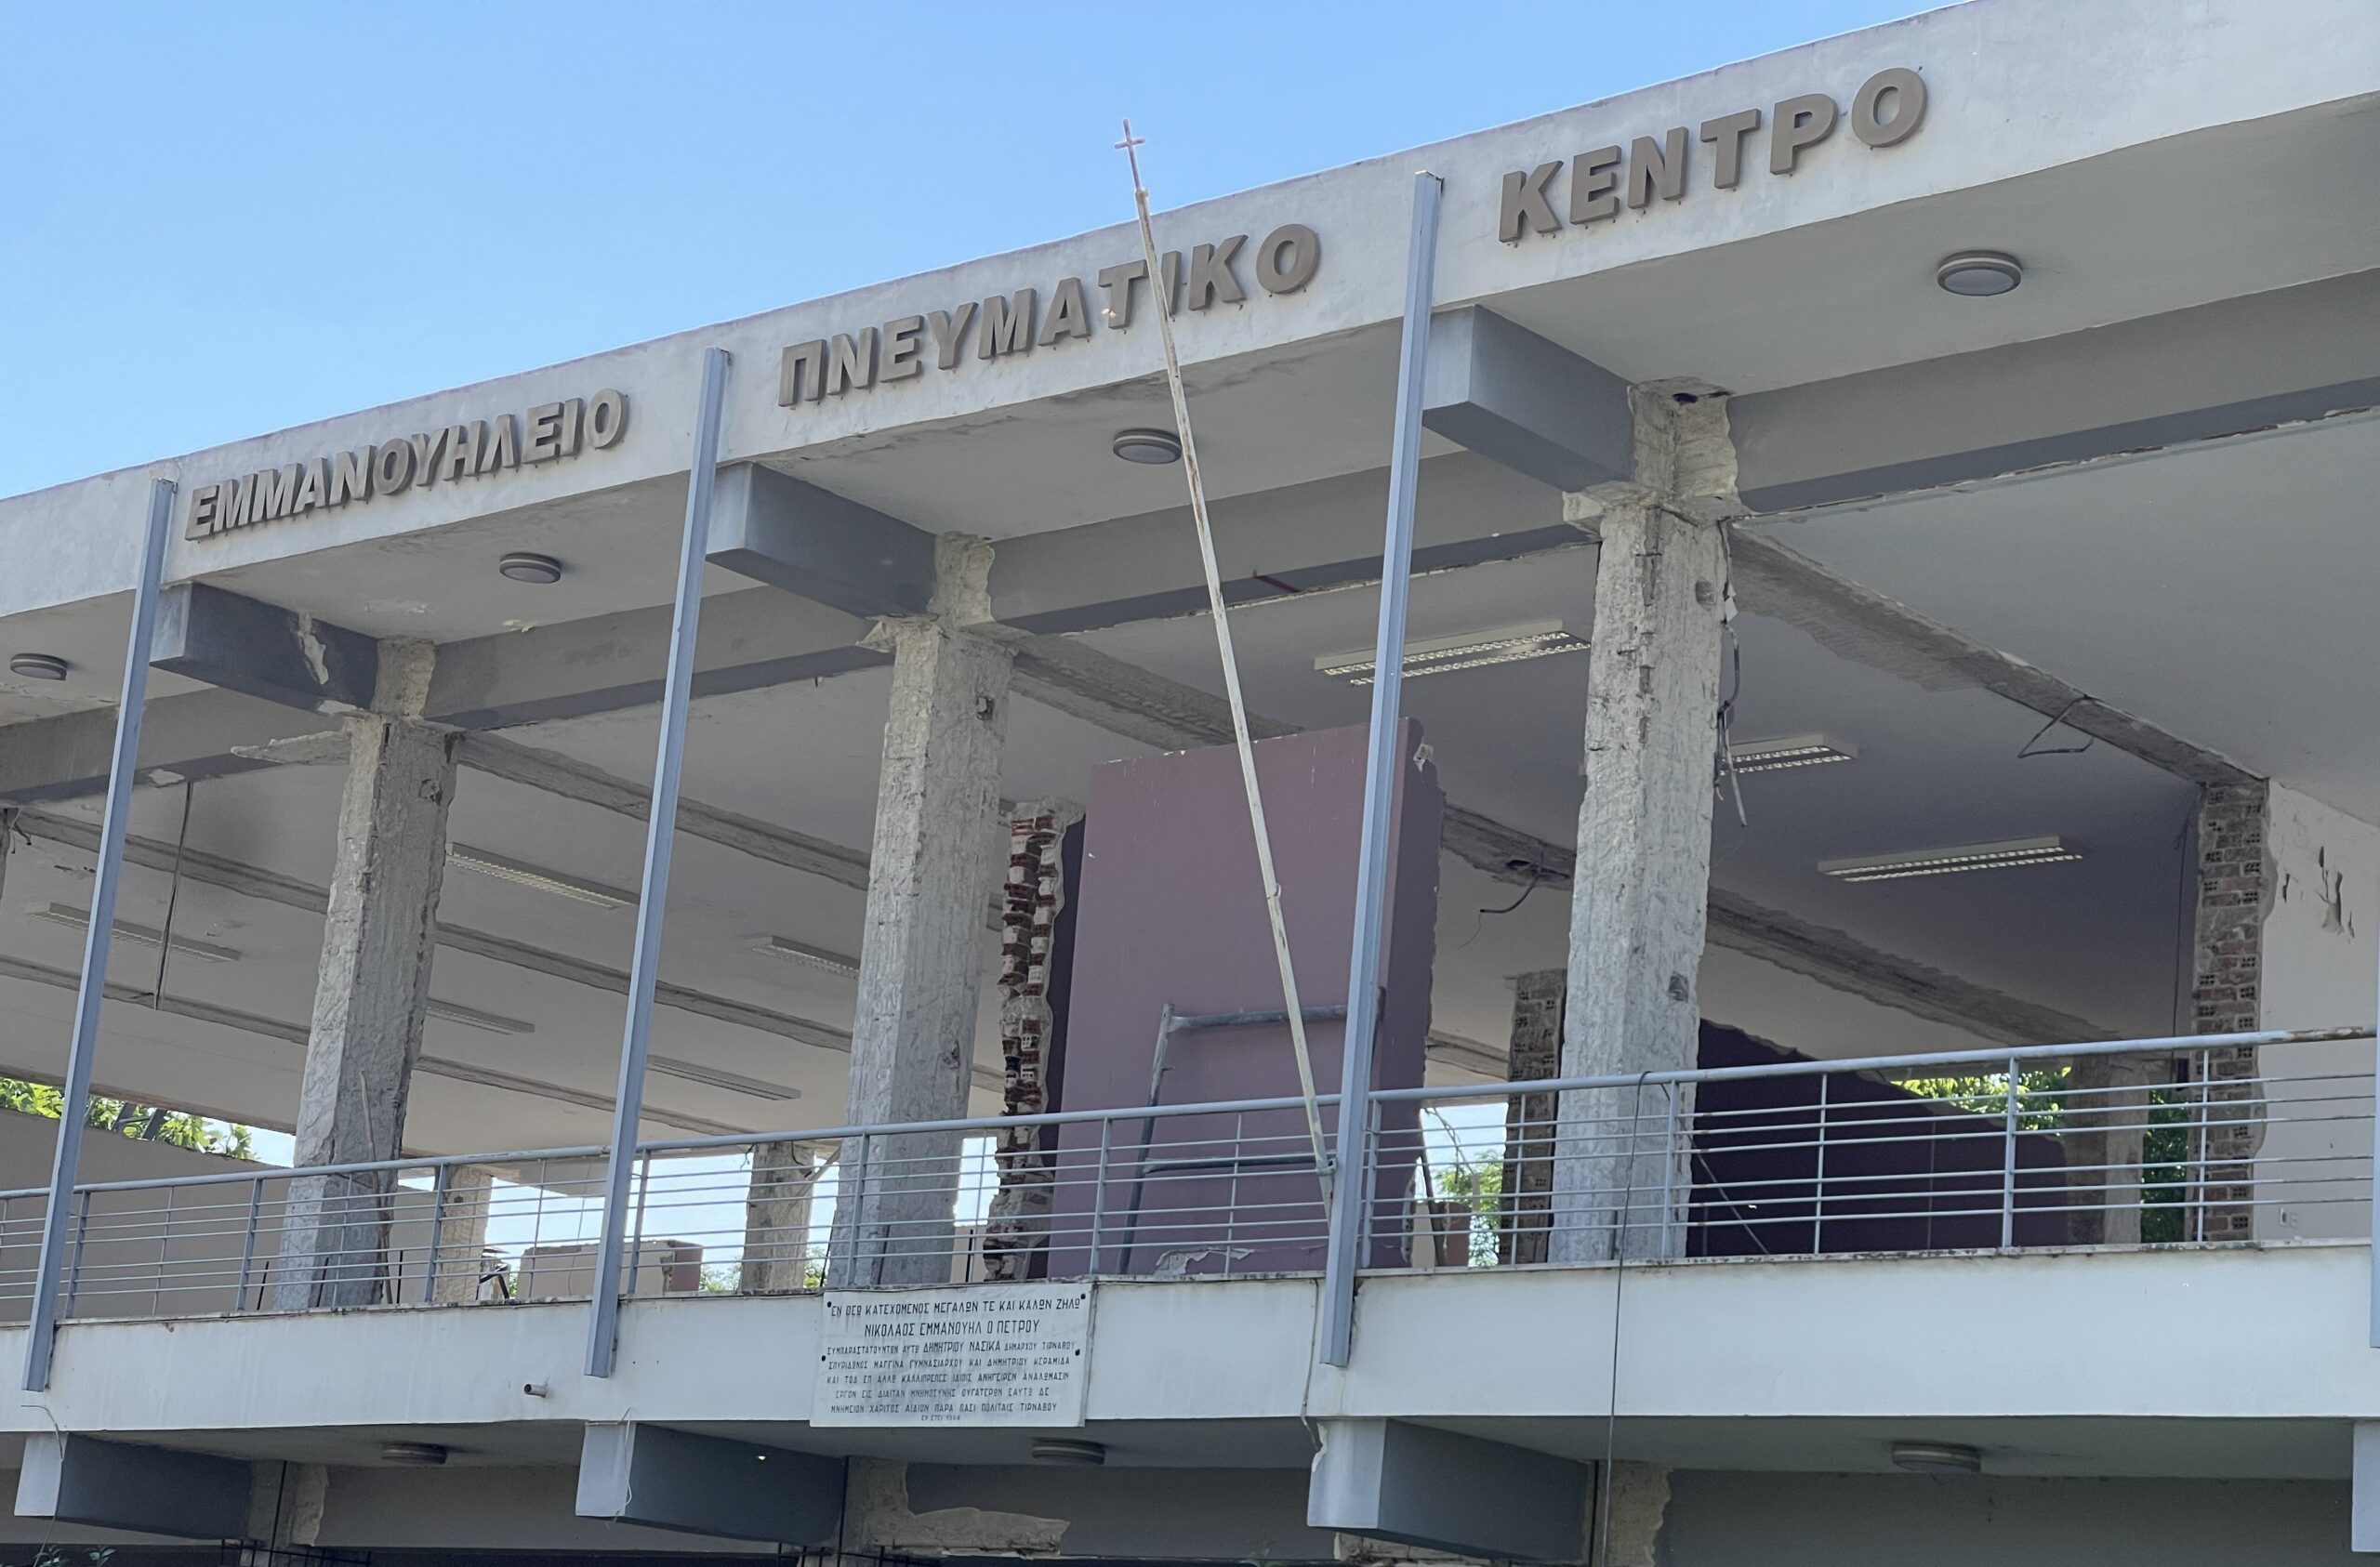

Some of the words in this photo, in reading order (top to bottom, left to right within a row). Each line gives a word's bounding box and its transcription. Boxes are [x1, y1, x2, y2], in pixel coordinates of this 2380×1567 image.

[185, 388, 629, 542] ΕΜΜΑΝΟΥΗΛΕΙΟ
[778, 223, 1321, 407] ΠΝΕΥΜΑΤΙΚΟ
[1499, 67, 1927, 244] ΚΕΝΤΡΟ
[831, 1305, 841, 1317] ΕΝ
[866, 1302, 930, 1316] ΚΑΤΕΧΟΜΕΝΟΣ
[934, 1301, 979, 1314] ΜΕΓΑΛΩΝ
[984, 1300, 995, 1311] ΤΕ
[999, 1300, 1015, 1310] ΚΑΙ
[1019, 1298, 1051, 1310] ΚΑΛΩΝ
[1056, 1297, 1080, 1310] ΖΗΛΩ
[865, 1323, 916, 1337] ΝΙΚΟΛΑΟΣ
[919, 1320, 982, 1337] ΕΜΜΑΝΟΥΗΛ
[987, 1320, 994, 1334] Ο
[997, 1319, 1039, 1334] ΠΕΤΡΟΥ
[923, 1340, 964, 1353] ΔΗΜΗΤΡΙΟΥ
[970, 1340, 1000, 1352] ΝΑΣΙΚΑ
[1004, 1342, 1037, 1351] ΔΗΜΑΡΧΟΥ
[874, 1360, 904, 1369] ΜΑΓΓΙΝΑ
[909, 1358, 963, 1369] ΓΥΜΝΑΣΙΑΡΧΟΥ
[969, 1358, 982, 1367] ΚΑΙ
[986, 1357, 1027, 1367] ΔΗΜΗΤΡΙΟΥ
[1034, 1356, 1070, 1366] ΚΕΡΑΜΙΔΑ
[826, 1376, 840, 1384] ΚΑΙ
[1038, 1387, 1050, 1396] ΔΕ
[830, 1404, 865, 1414] ΜΝΗΜΕΙΟΝ
[869, 1403, 900, 1414] ΧΑΡΙΤΟΣ
[934, 1402, 954, 1413] ΠΑΡΑ
[1020, 1402, 1058, 1412] ΤΙΡΝΑΒΟΥ
